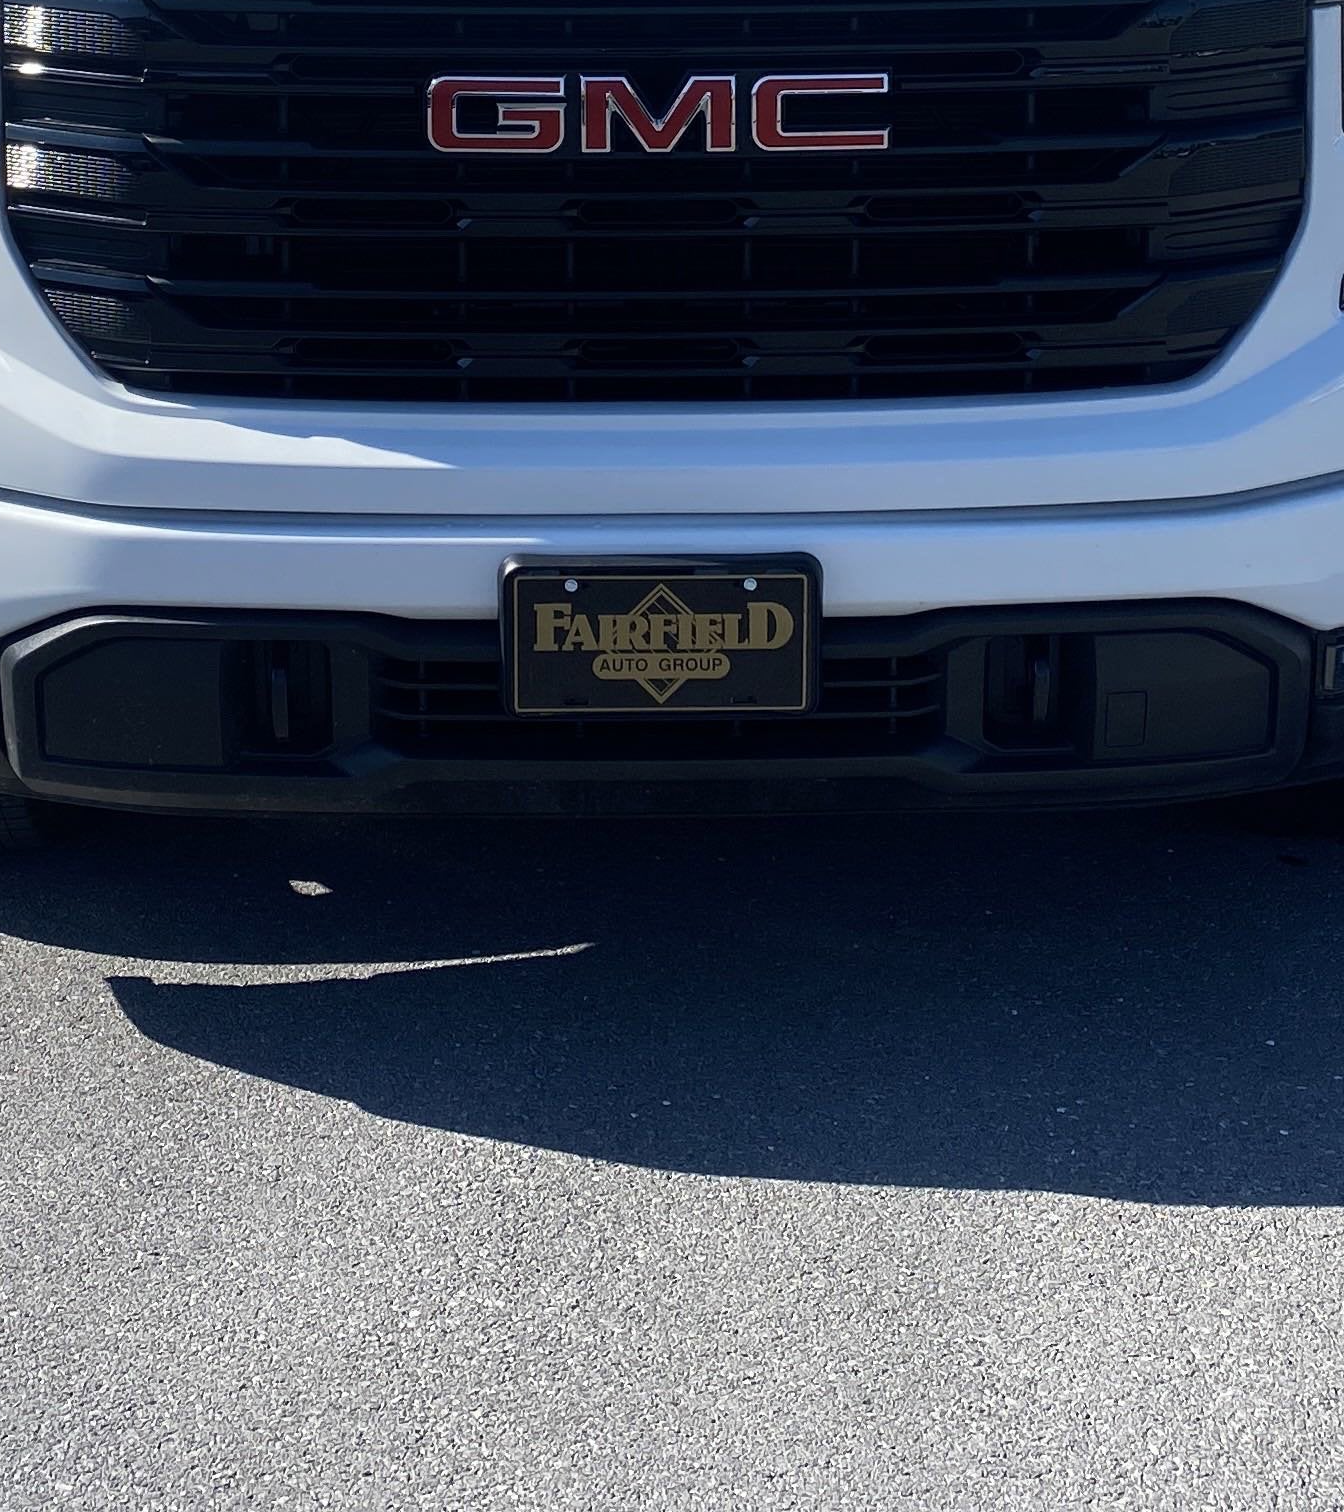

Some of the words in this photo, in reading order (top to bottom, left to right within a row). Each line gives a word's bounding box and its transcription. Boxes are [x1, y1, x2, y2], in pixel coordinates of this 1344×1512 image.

[427, 73, 890, 152] GMC
[533, 602, 794, 651] FAIRFIELD
[599, 657, 648, 672] AUTO
[658, 657, 723, 672] GROUP
